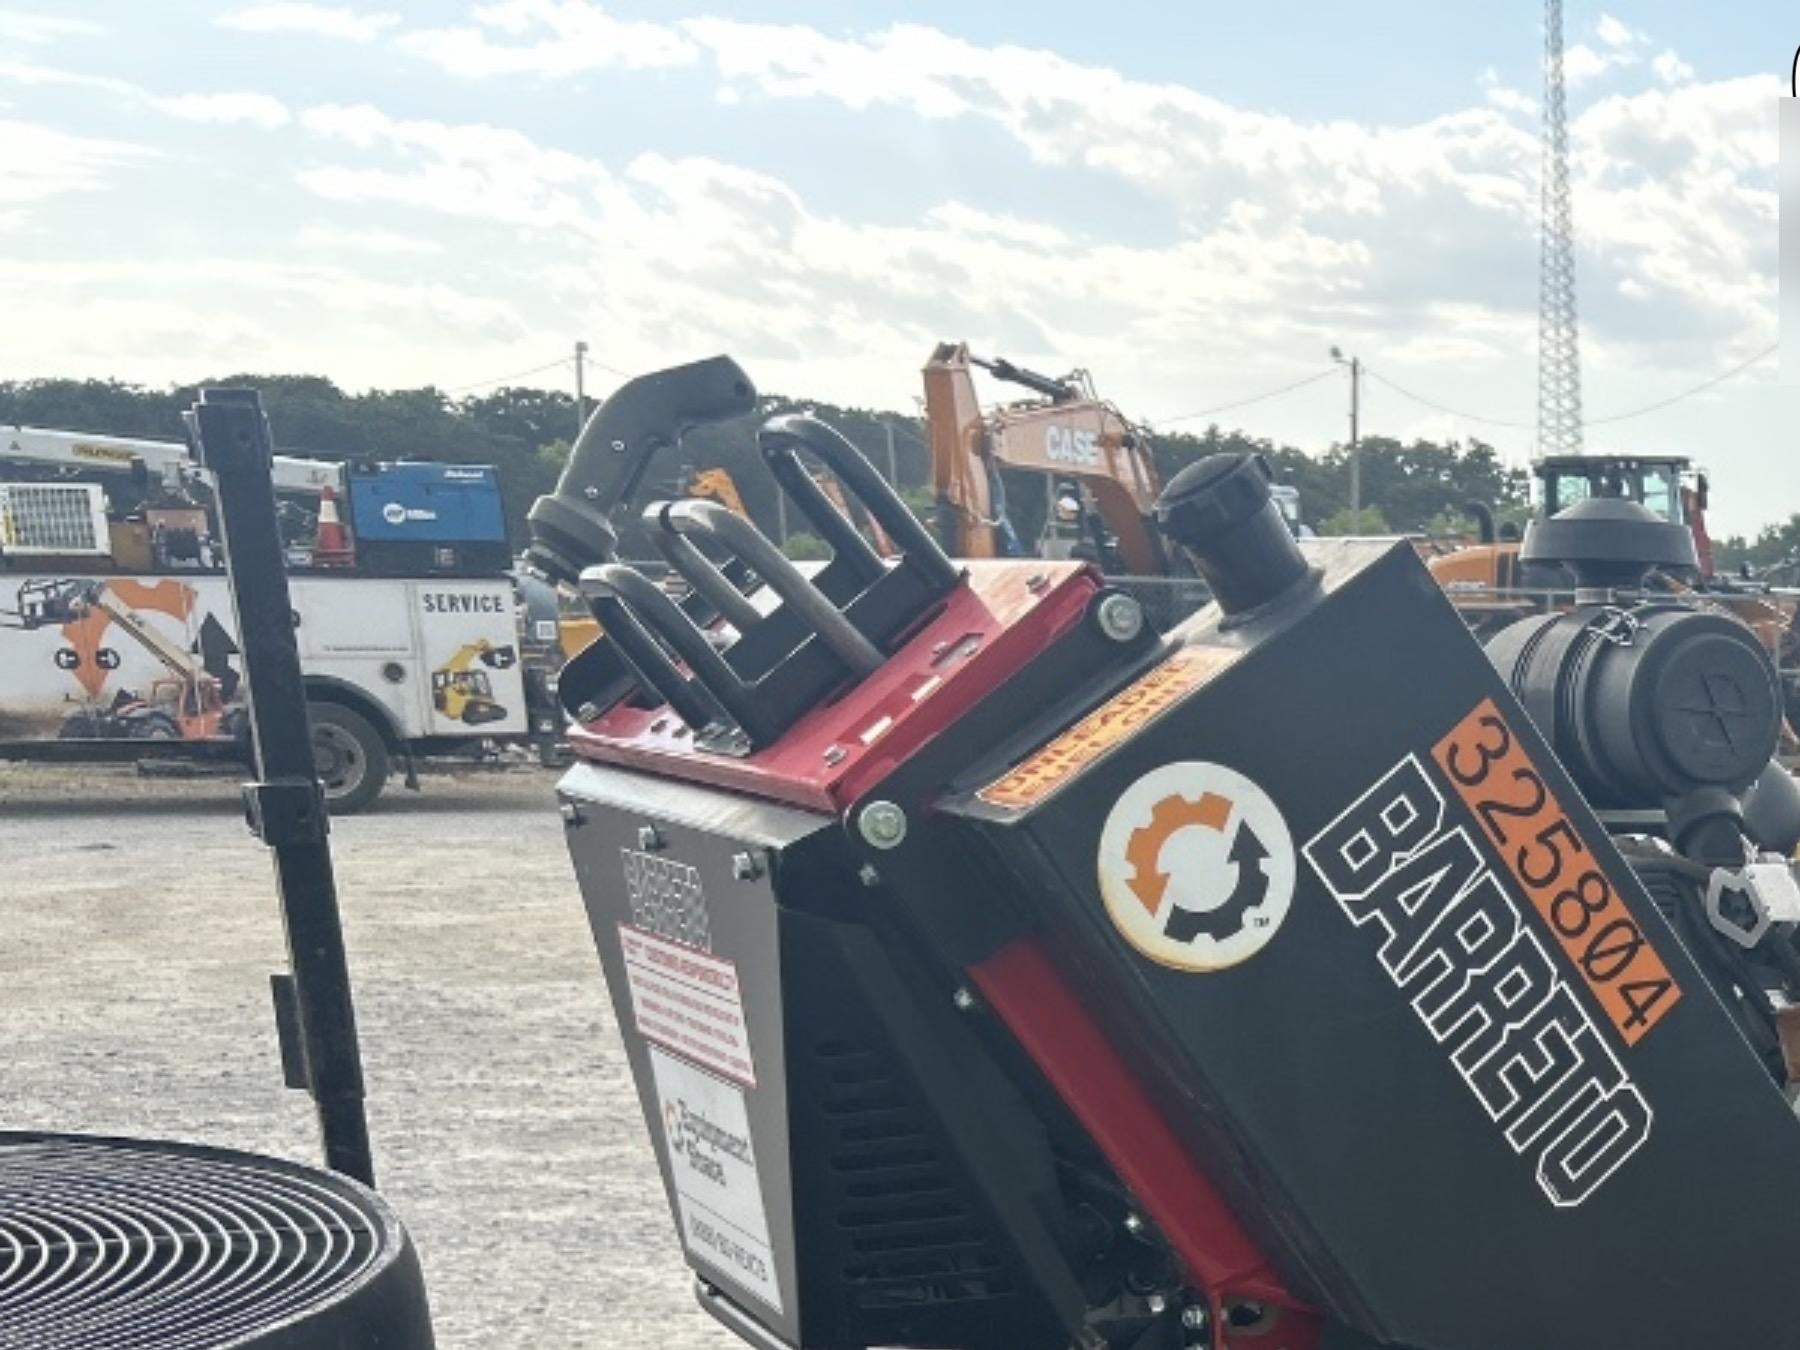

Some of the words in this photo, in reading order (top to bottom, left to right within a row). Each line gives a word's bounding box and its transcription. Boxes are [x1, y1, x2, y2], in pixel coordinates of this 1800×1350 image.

[1046, 425, 1099, 464] CASE
[421, 593, 504, 613] SERVICE
[1446, 715, 1672, 1033] 325804
[1301, 751, 1654, 1207] BARRETO
